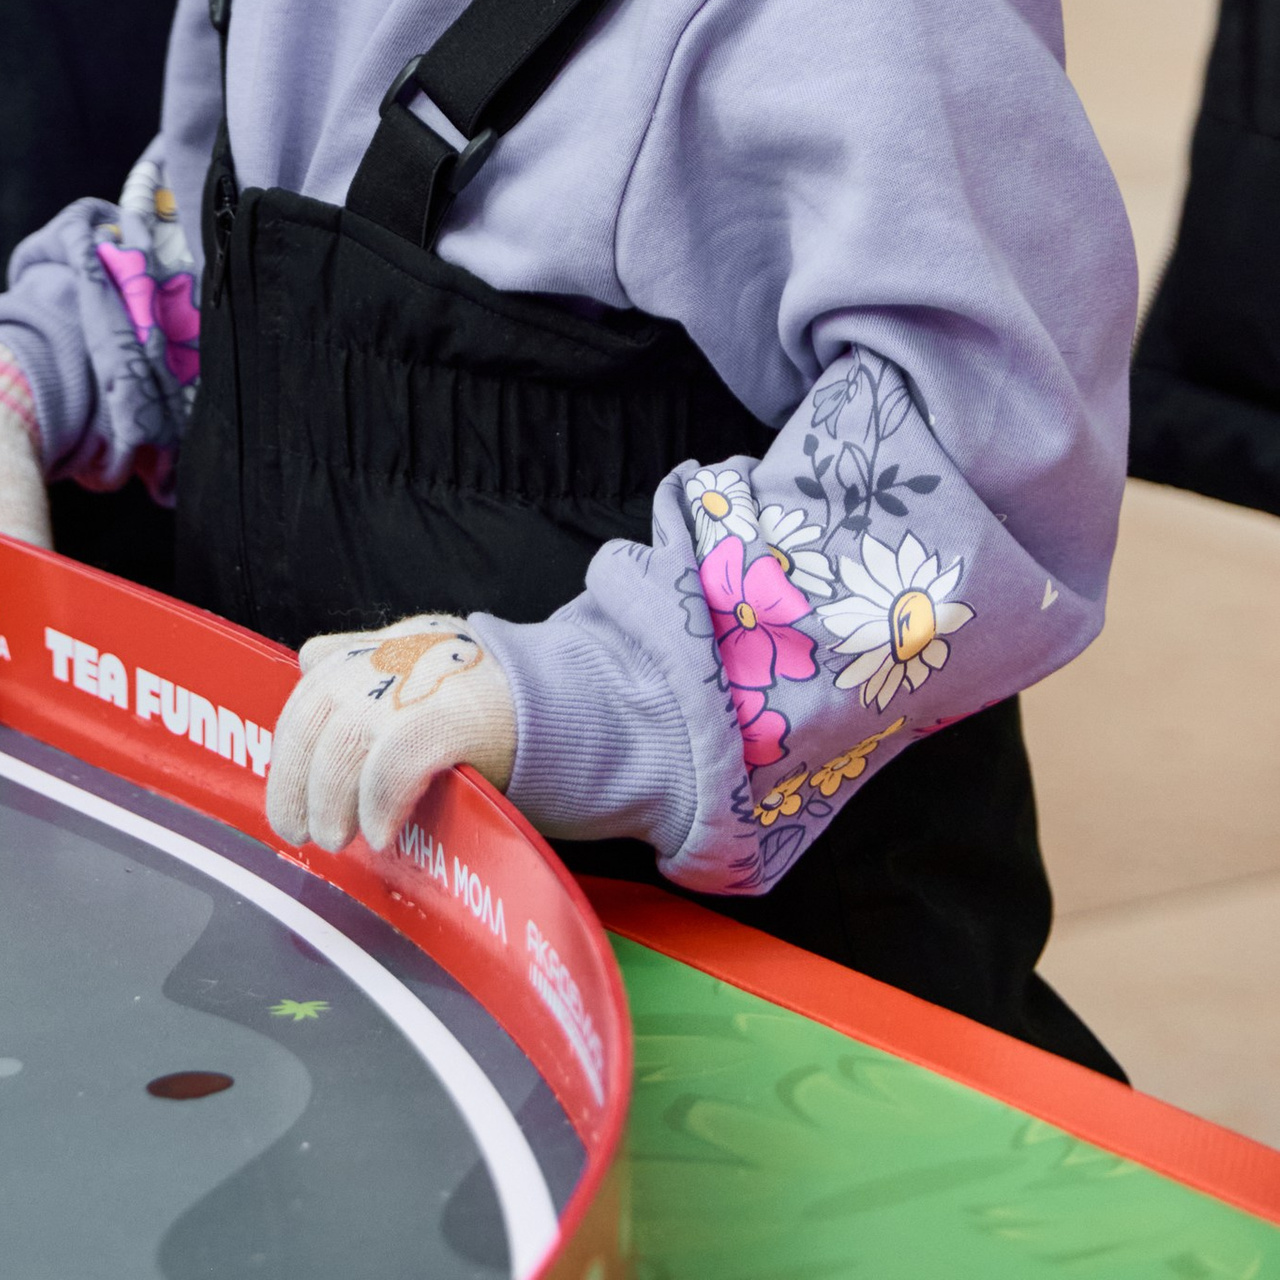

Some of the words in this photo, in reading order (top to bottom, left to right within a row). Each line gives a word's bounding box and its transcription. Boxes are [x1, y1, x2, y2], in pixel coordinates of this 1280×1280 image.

[45, 626, 128, 710] TEA
[136, 666, 273, 778] FUNNY
[398, 820, 449, 889] ИНА
[453, 855, 508, 946] МОЛЛ
